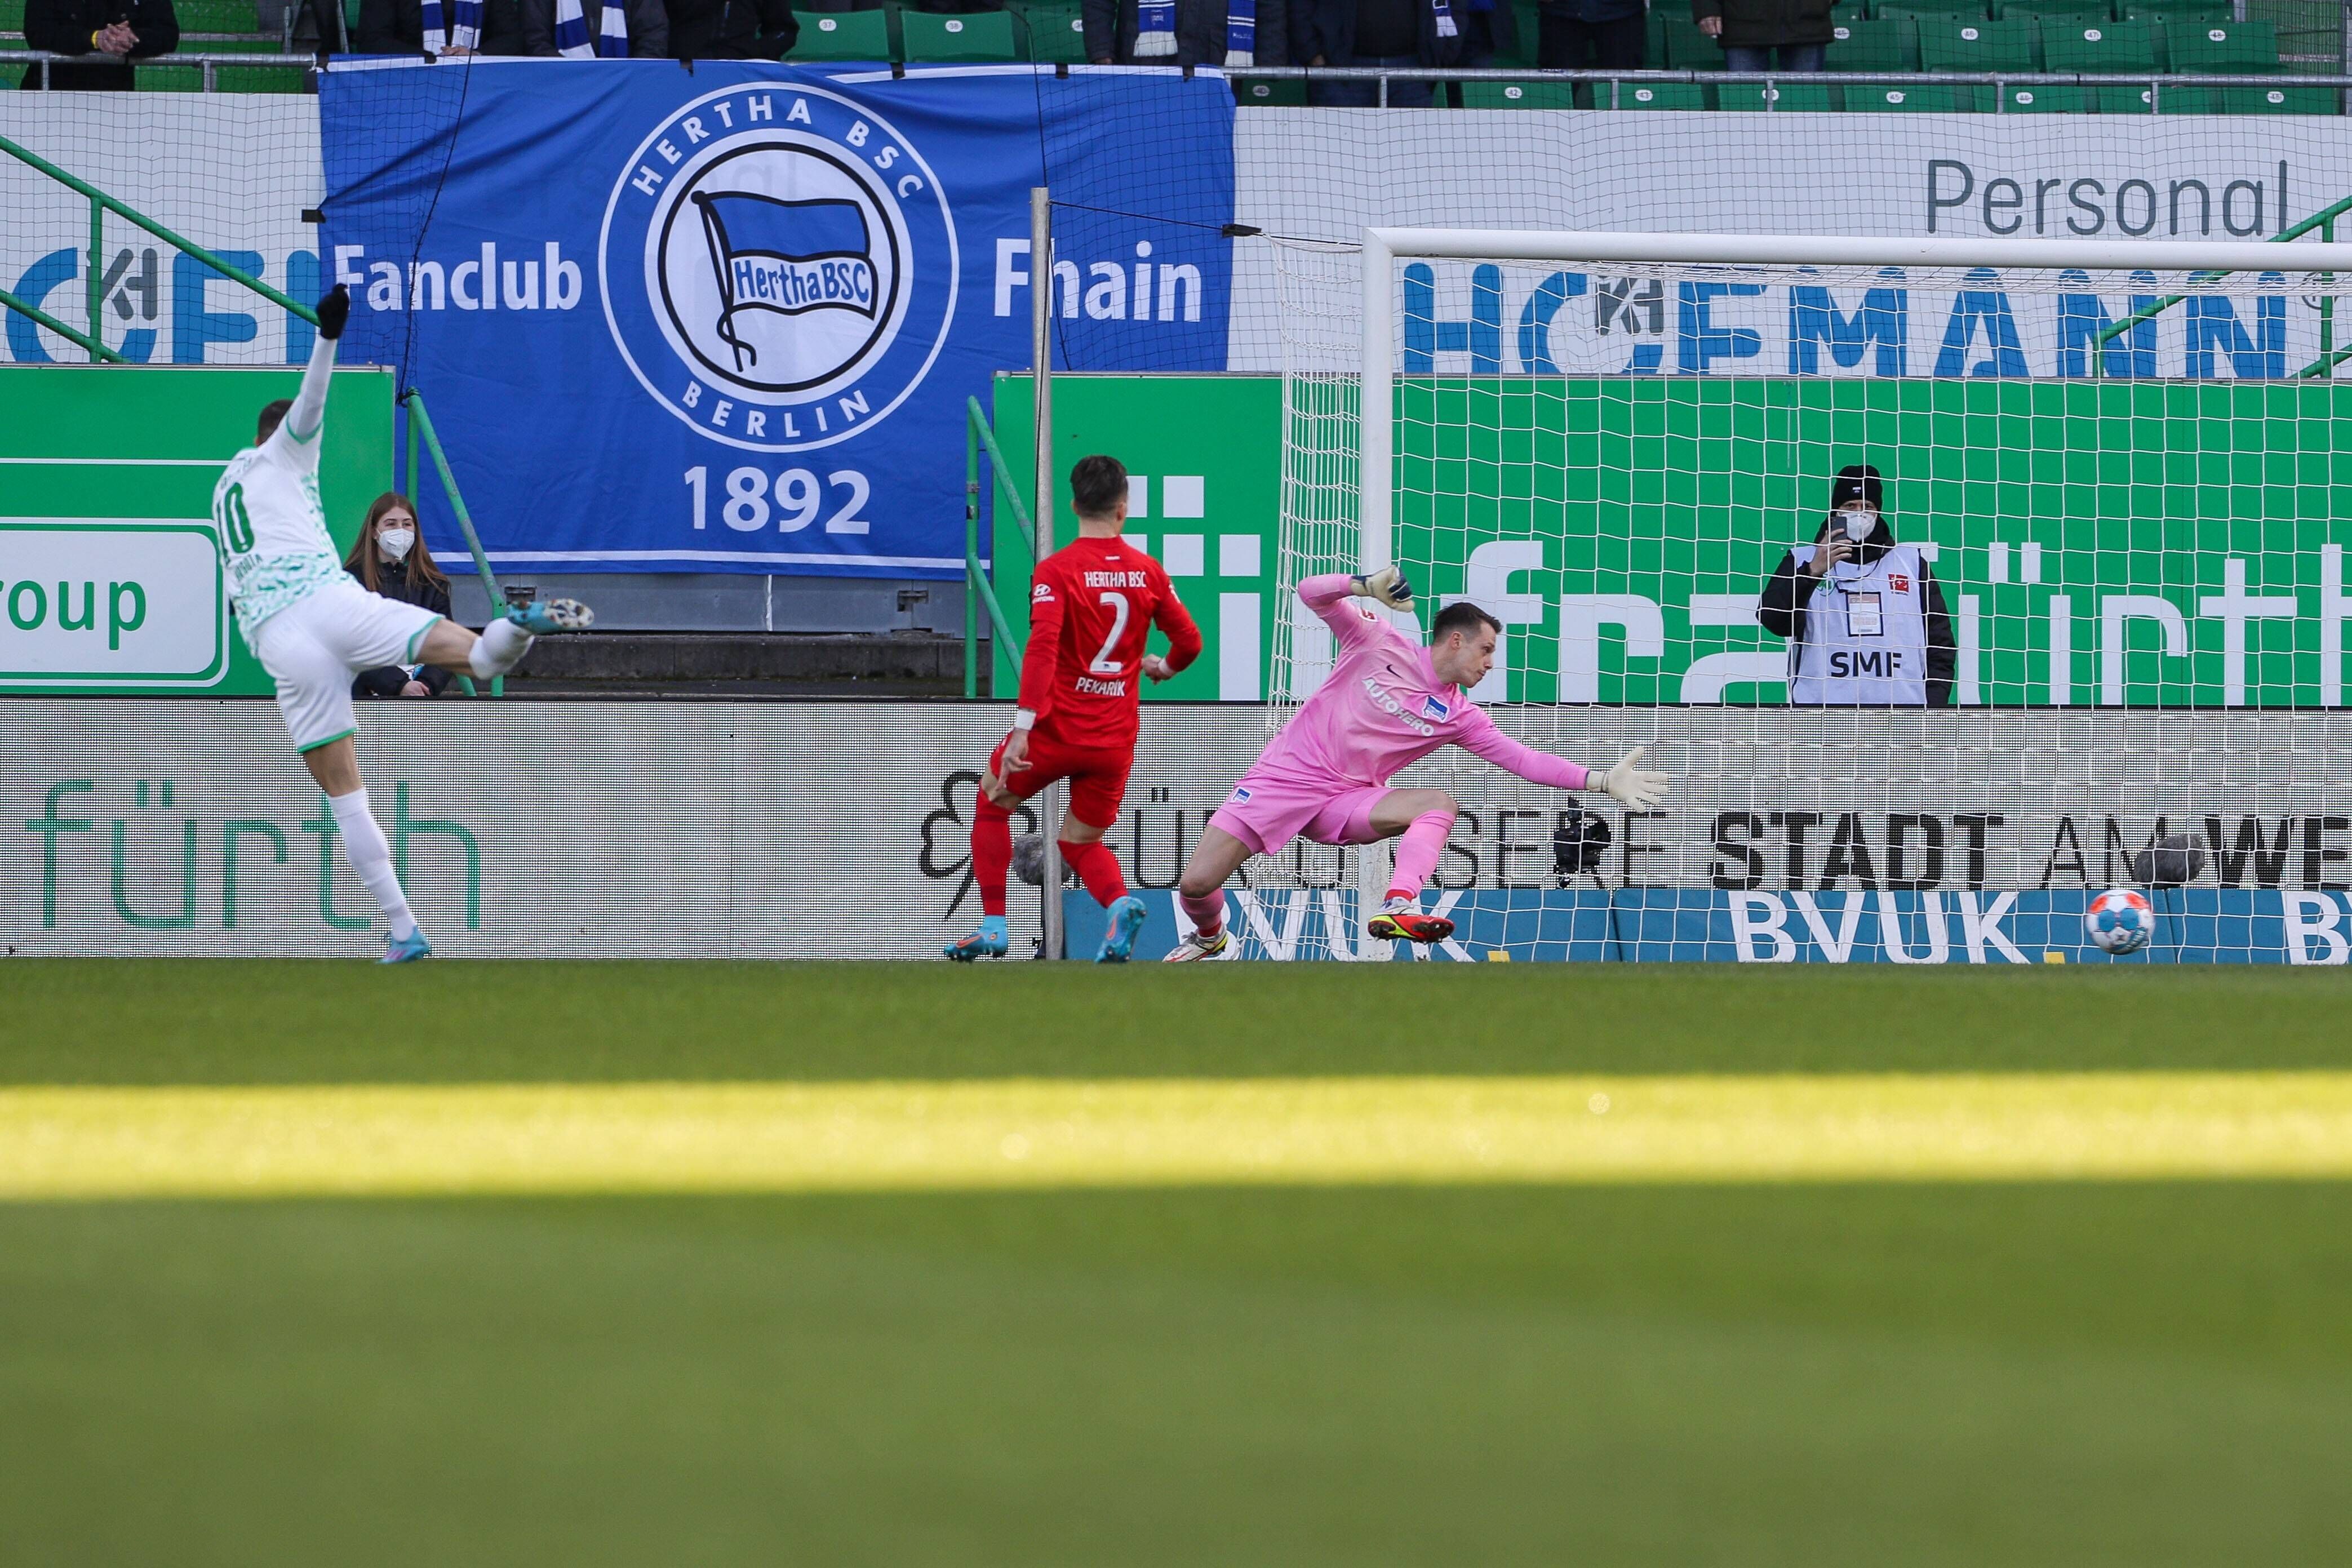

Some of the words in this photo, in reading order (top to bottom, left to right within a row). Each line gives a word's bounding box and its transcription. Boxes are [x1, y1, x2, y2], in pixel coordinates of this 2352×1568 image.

[632, 95, 812, 197] HERTHA
[845, 119, 924, 199] BSC
[1927, 159, 2288, 237] Personal
[334, 241, 583, 312] Fanclub
[682, 380, 871, 438] BERLIN
[684, 465, 871, 535] 1892
[1083, 571, 1126, 588] HERTHA
[1128, 571, 1147, 588] BSC
[1089, 592, 1129, 673] 2
[1830, 651, 1902, 678] SMF
[1361, 677, 1435, 737] AUTOHERO
[25, 779, 481, 929] fürth
[1711, 812, 2004, 891] STADT
